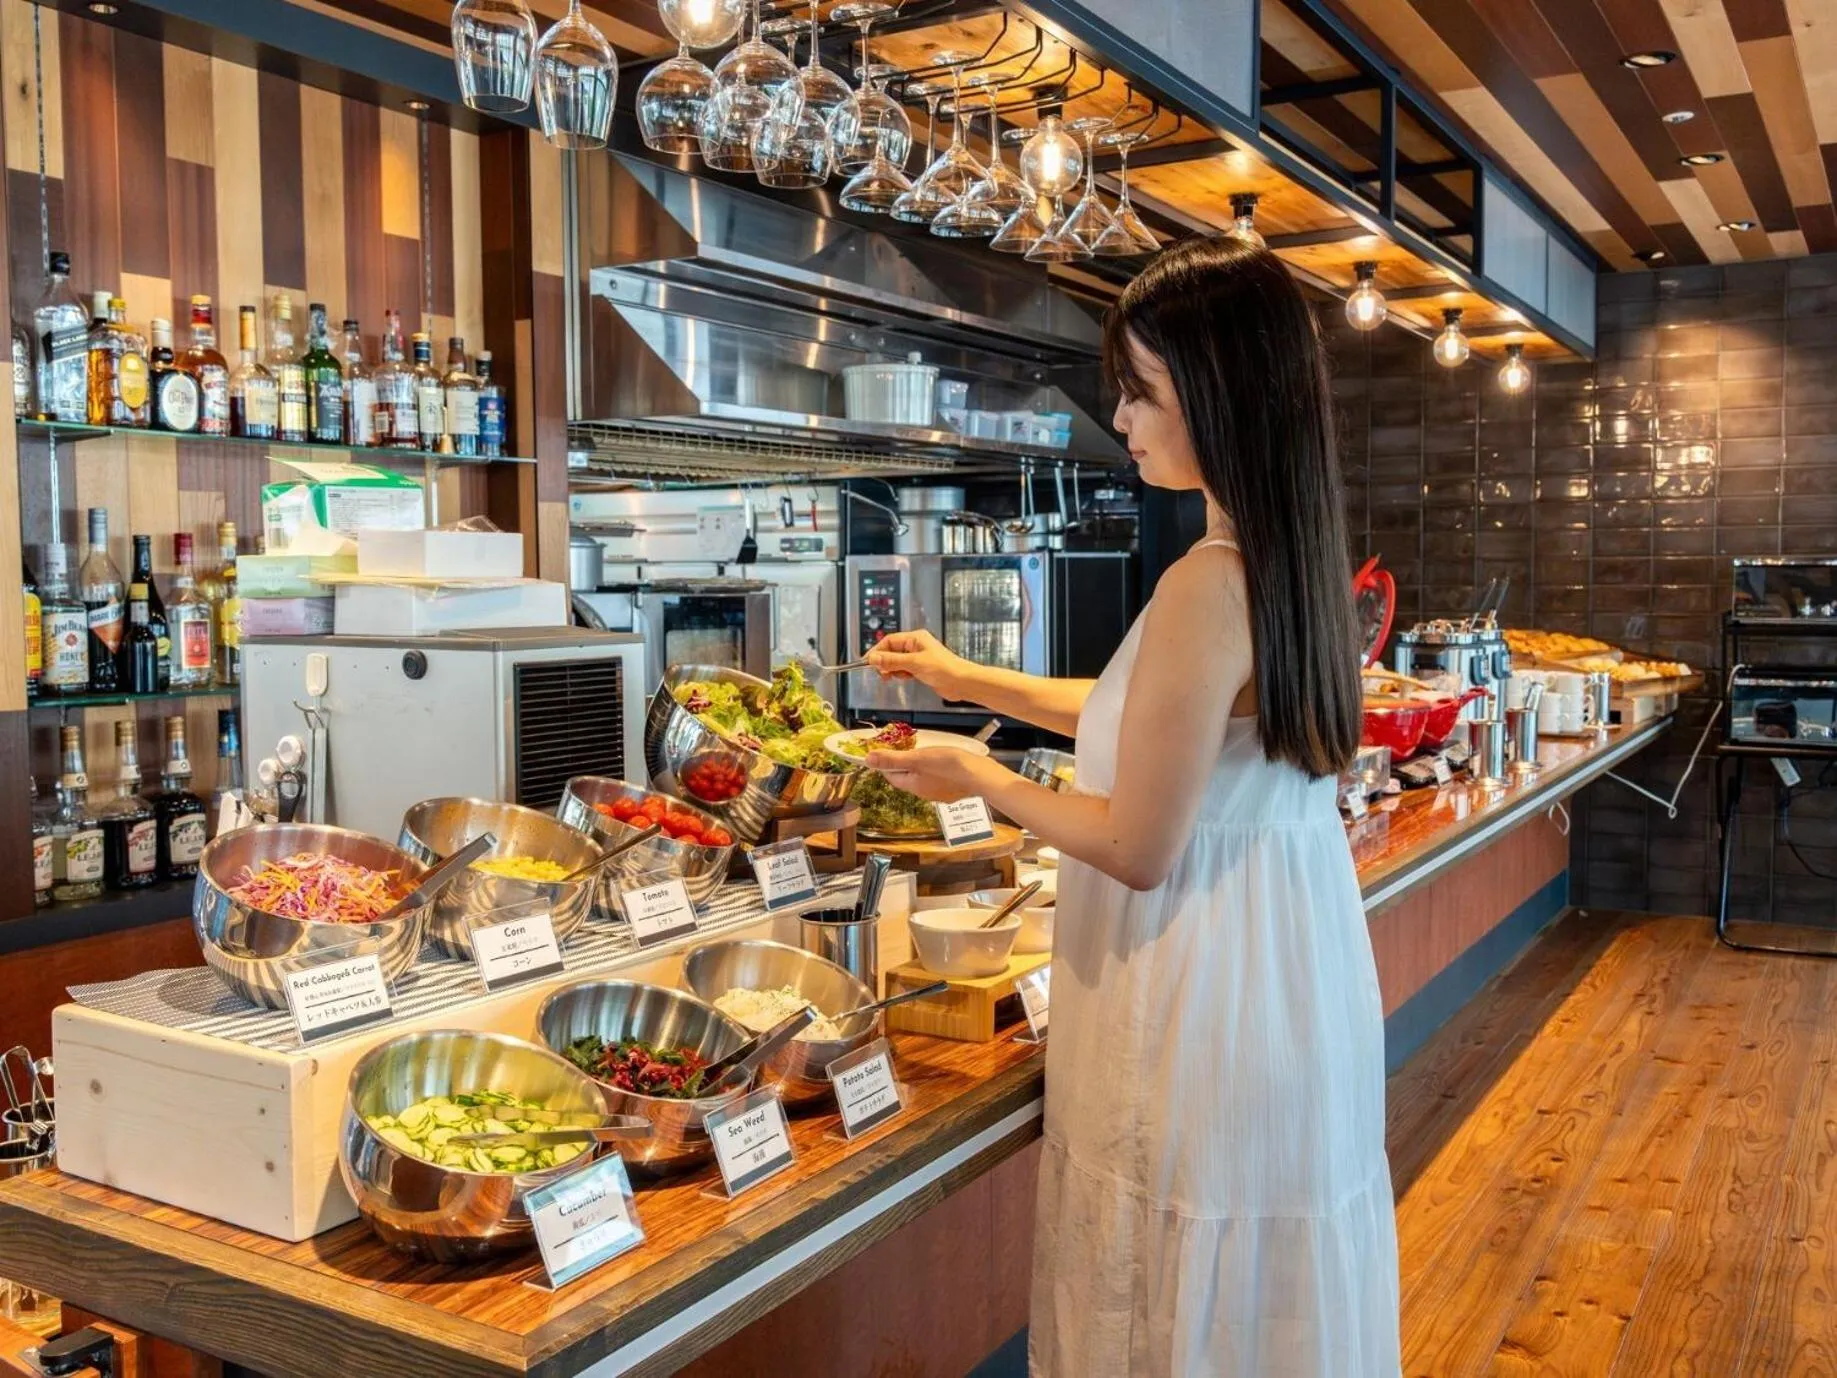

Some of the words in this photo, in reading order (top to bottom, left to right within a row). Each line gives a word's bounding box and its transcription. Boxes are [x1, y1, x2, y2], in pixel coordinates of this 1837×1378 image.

[642, 889, 669, 902] Tomato
[503, 926, 526, 938] Corn
[512, 957, 532, 968] コーン
[293, 977, 310, 989] Red
[352, 963, 376, 975] Carrot
[842, 1071, 865, 1088] Potato
[865, 1060, 883, 1077] Salad
[728, 1125, 743, 1138] Sea
[743, 1109, 765, 1128] Weed
[559, 1188, 608, 1217] Cucumber
